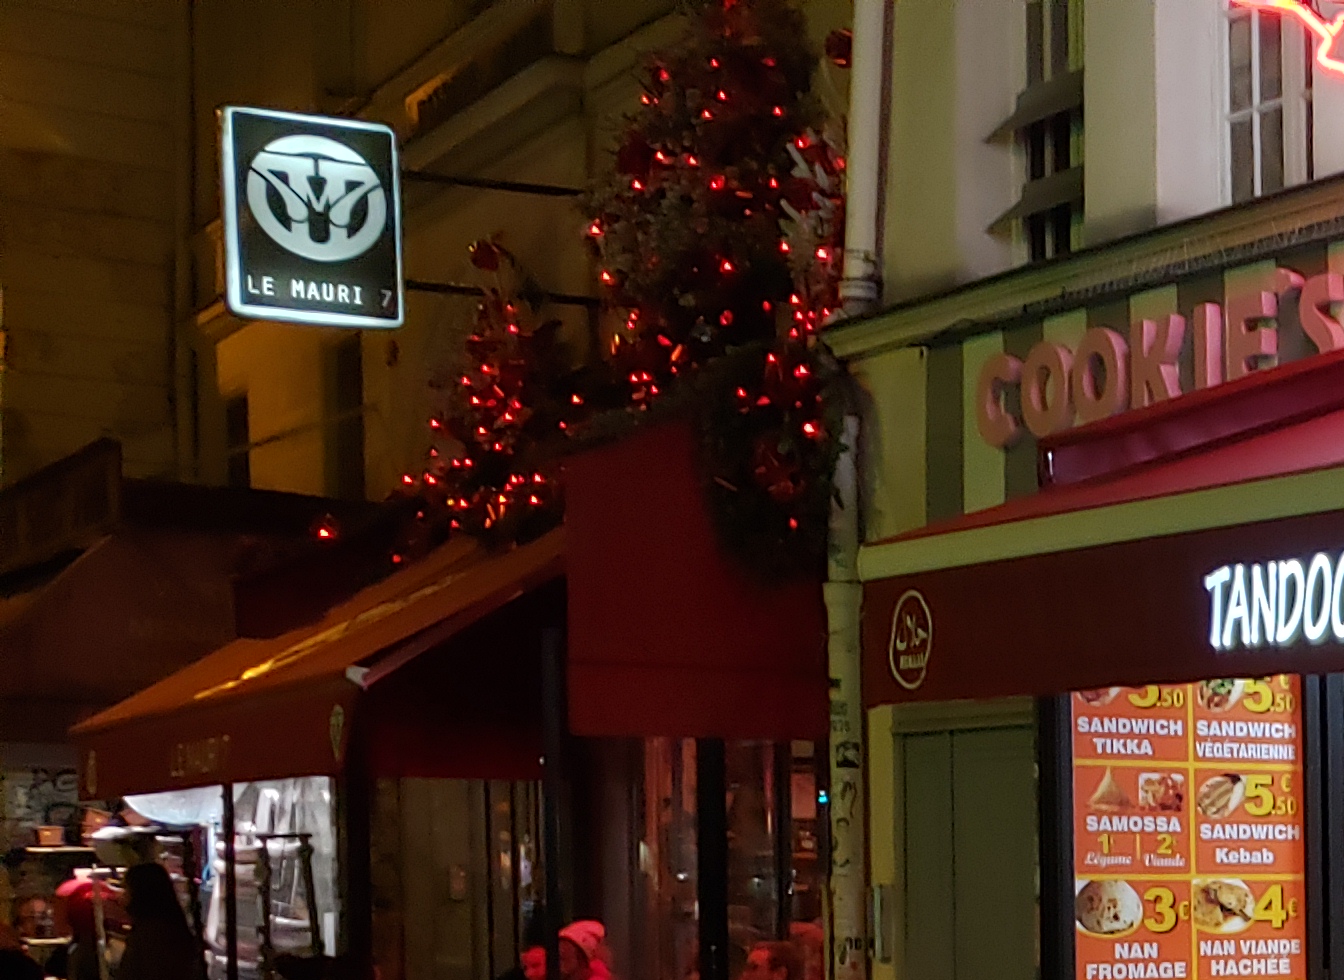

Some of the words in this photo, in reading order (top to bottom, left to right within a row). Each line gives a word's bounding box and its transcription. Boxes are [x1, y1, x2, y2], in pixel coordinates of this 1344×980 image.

[247, 274, 274, 296] LE
[291, 278, 363, 305] MAURI
[380, 289, 392, 308] 7
[1077, 716, 1184, 736] SANDWICH
[1196, 720, 1296, 739] SANDWICH
[1092, 737, 1153, 756] TIKKA
[1195, 739, 1296, 760] VÉGÉTARIENNE
[1086, 815, 1181, 833] SAMOSSA
[1200, 823, 1300, 841] SANDWICH
[1215, 847, 1274, 864] Kebab
[1114, 942, 1158, 960] NAN
[1200, 940, 1236, 956] NAN
[1240, 939, 1301, 956] VIANDE
[1086, 962, 1187, 980] FROMAGE
